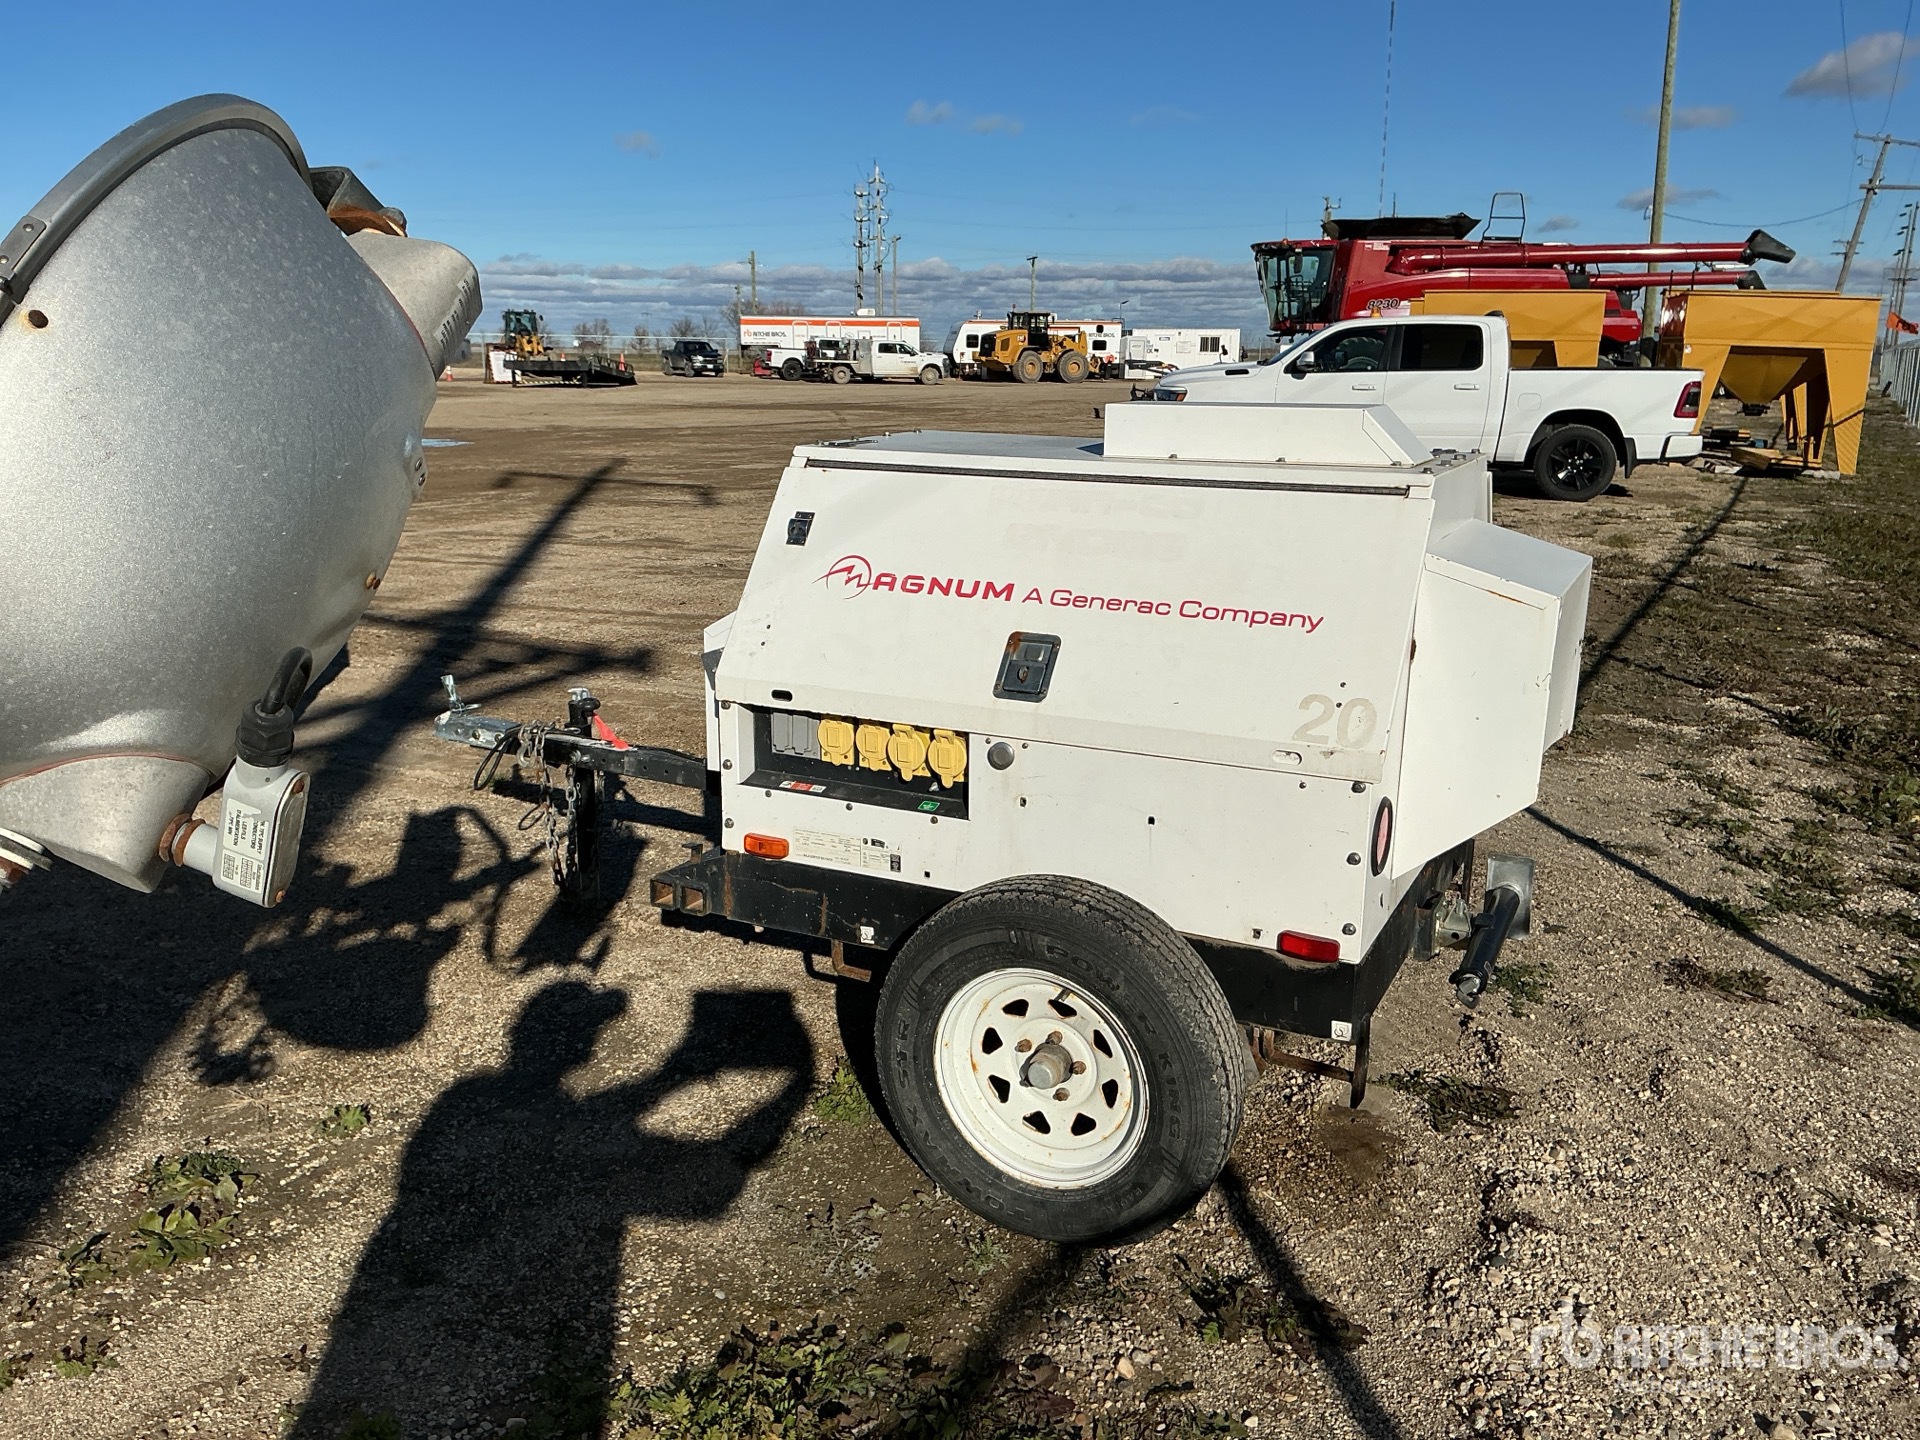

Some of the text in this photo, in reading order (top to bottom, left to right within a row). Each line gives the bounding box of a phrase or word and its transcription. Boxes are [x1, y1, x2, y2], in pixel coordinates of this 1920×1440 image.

[1366, 298, 1399, 310] 8230
[1021, 587, 1043, 605] A
[1050, 590, 1171, 616] Generac
[1179, 600, 1325, 634] Company
[1292, 693, 1378, 749] 20
[1045, 943, 1182, 1140] POWER KING
